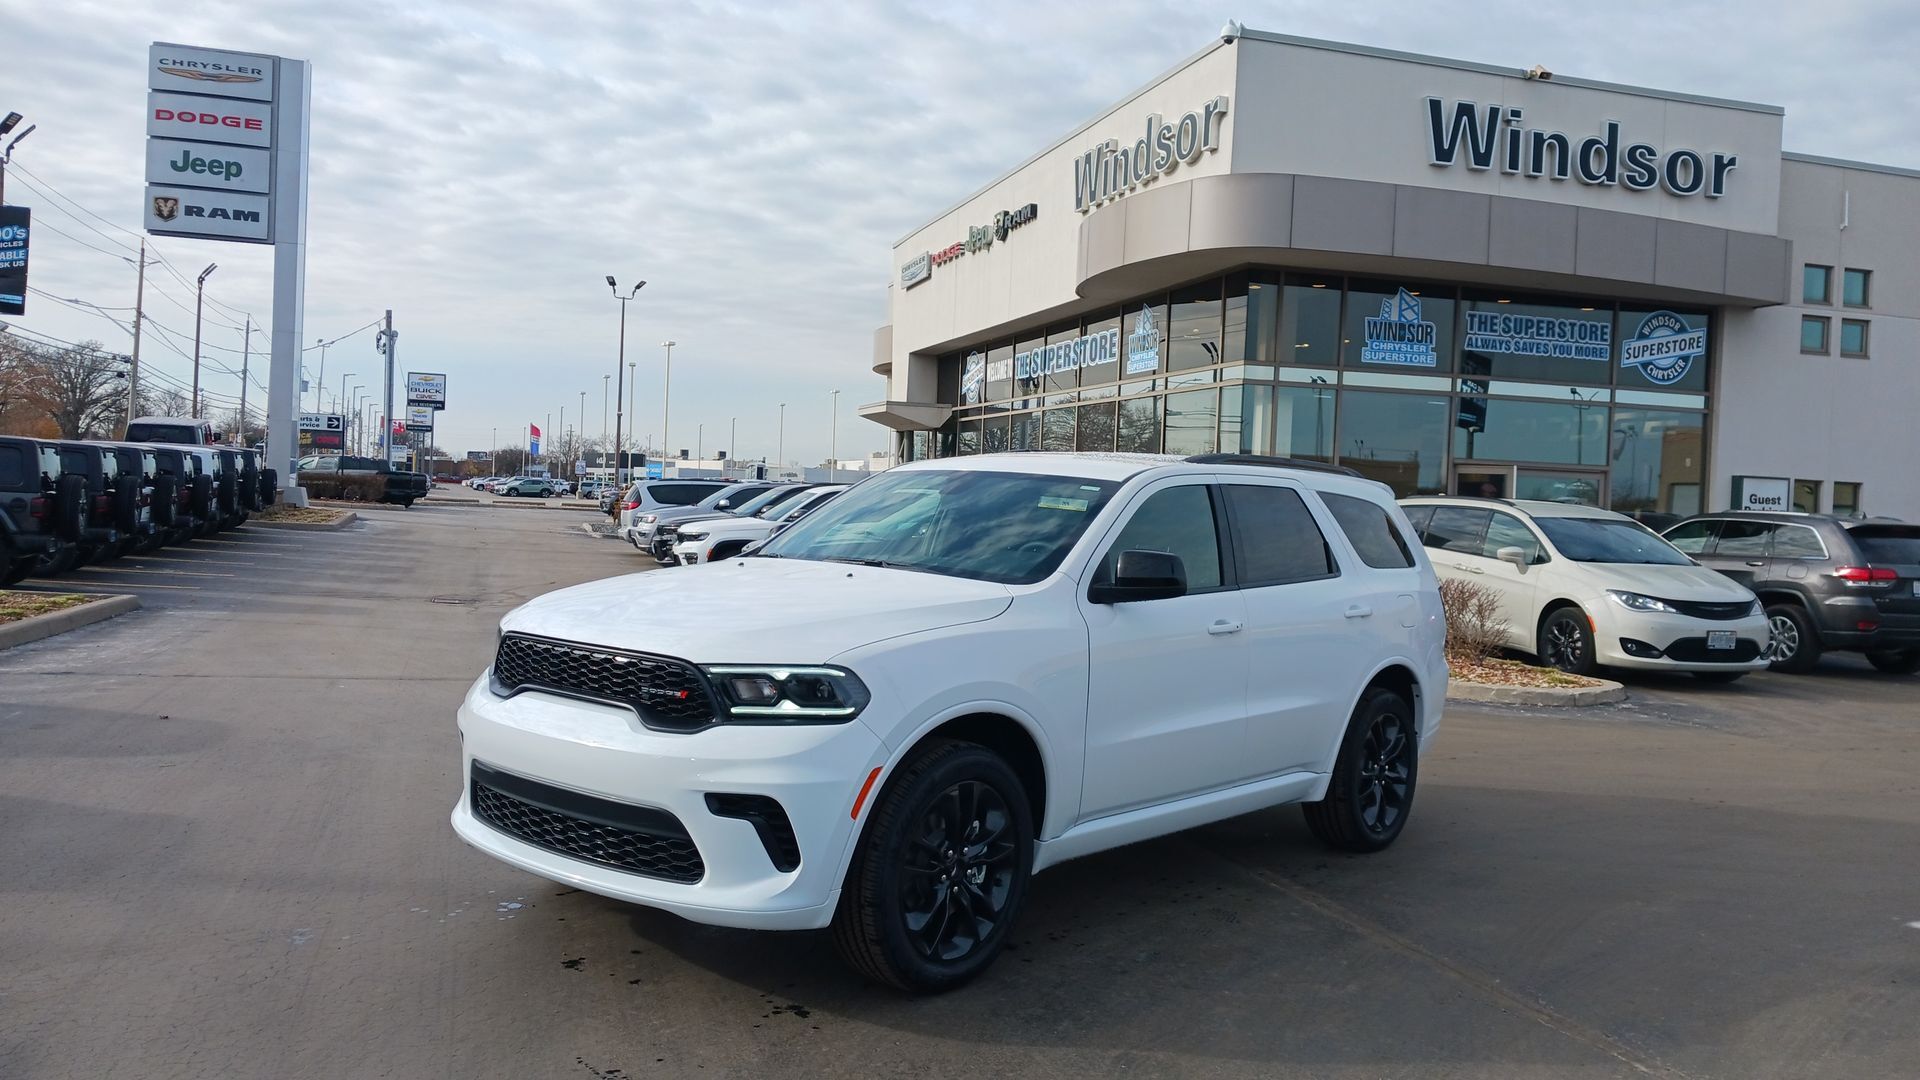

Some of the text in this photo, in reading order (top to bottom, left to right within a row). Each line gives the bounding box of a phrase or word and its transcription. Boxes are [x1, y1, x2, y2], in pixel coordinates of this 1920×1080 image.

[158, 57, 263, 76] CHRYSLER
[155, 108, 263, 131] DODGE
[1074, 95, 1229, 213] Windsor
[1425, 96, 1738, 198] Windsor
[169, 149, 243, 182] Jeep
[184, 204, 260, 223] RAM
[1003, 202, 1038, 230] RAM
[12, 259, 25, 268] US
[901, 255, 926, 274] CHRYSLER
[931, 241, 966, 266] DODGE
[1367, 320, 1434, 345] WINDSOR
[1466, 312, 1610, 343] THE SUPERSTORE
[1641, 316, 1681, 336] WINDSOR
[1016, 353, 1030, 379] THE
[1031, 329, 1119, 377] SUPERSTORE
[1364, 350, 1434, 364] SUPERSTORE
[1372, 341, 1427, 353] CHRYSLER
[1465, 335, 1609, 361] ALWAYS SAVES YOU MORE!
[1625, 335, 1703, 360] SUPERSTORE
[1647, 358, 1686, 380] CHRYSLER
[1749, 493, 1782, 506] Guest
